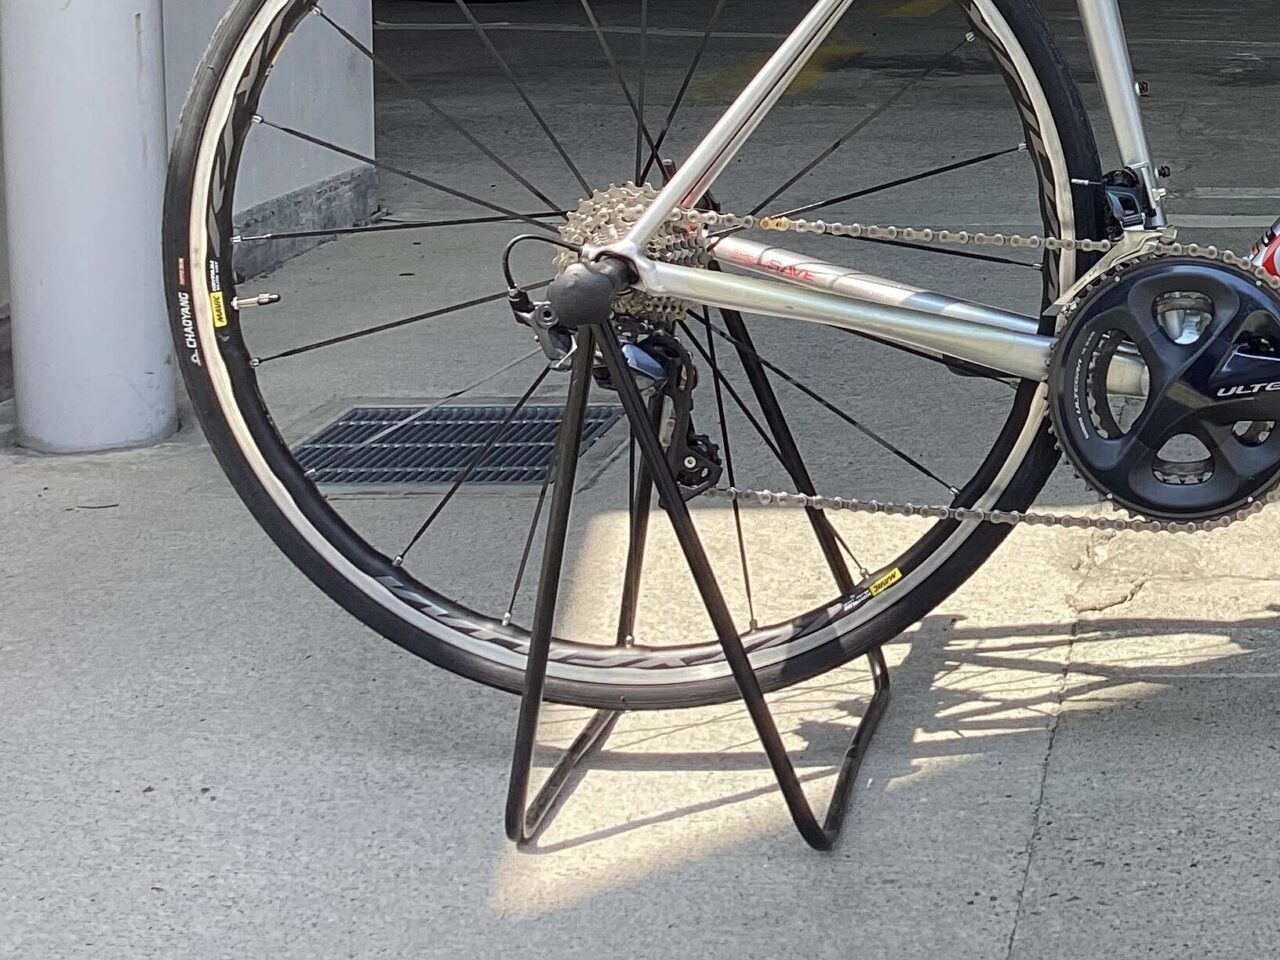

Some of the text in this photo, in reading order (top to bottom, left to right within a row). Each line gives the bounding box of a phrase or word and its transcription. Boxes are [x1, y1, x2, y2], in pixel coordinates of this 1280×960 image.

[178, 292, 197, 348] CHAOYANG
[213, 295, 224, 323] MAVIC
[873, 572, 897, 593] MAVIC
